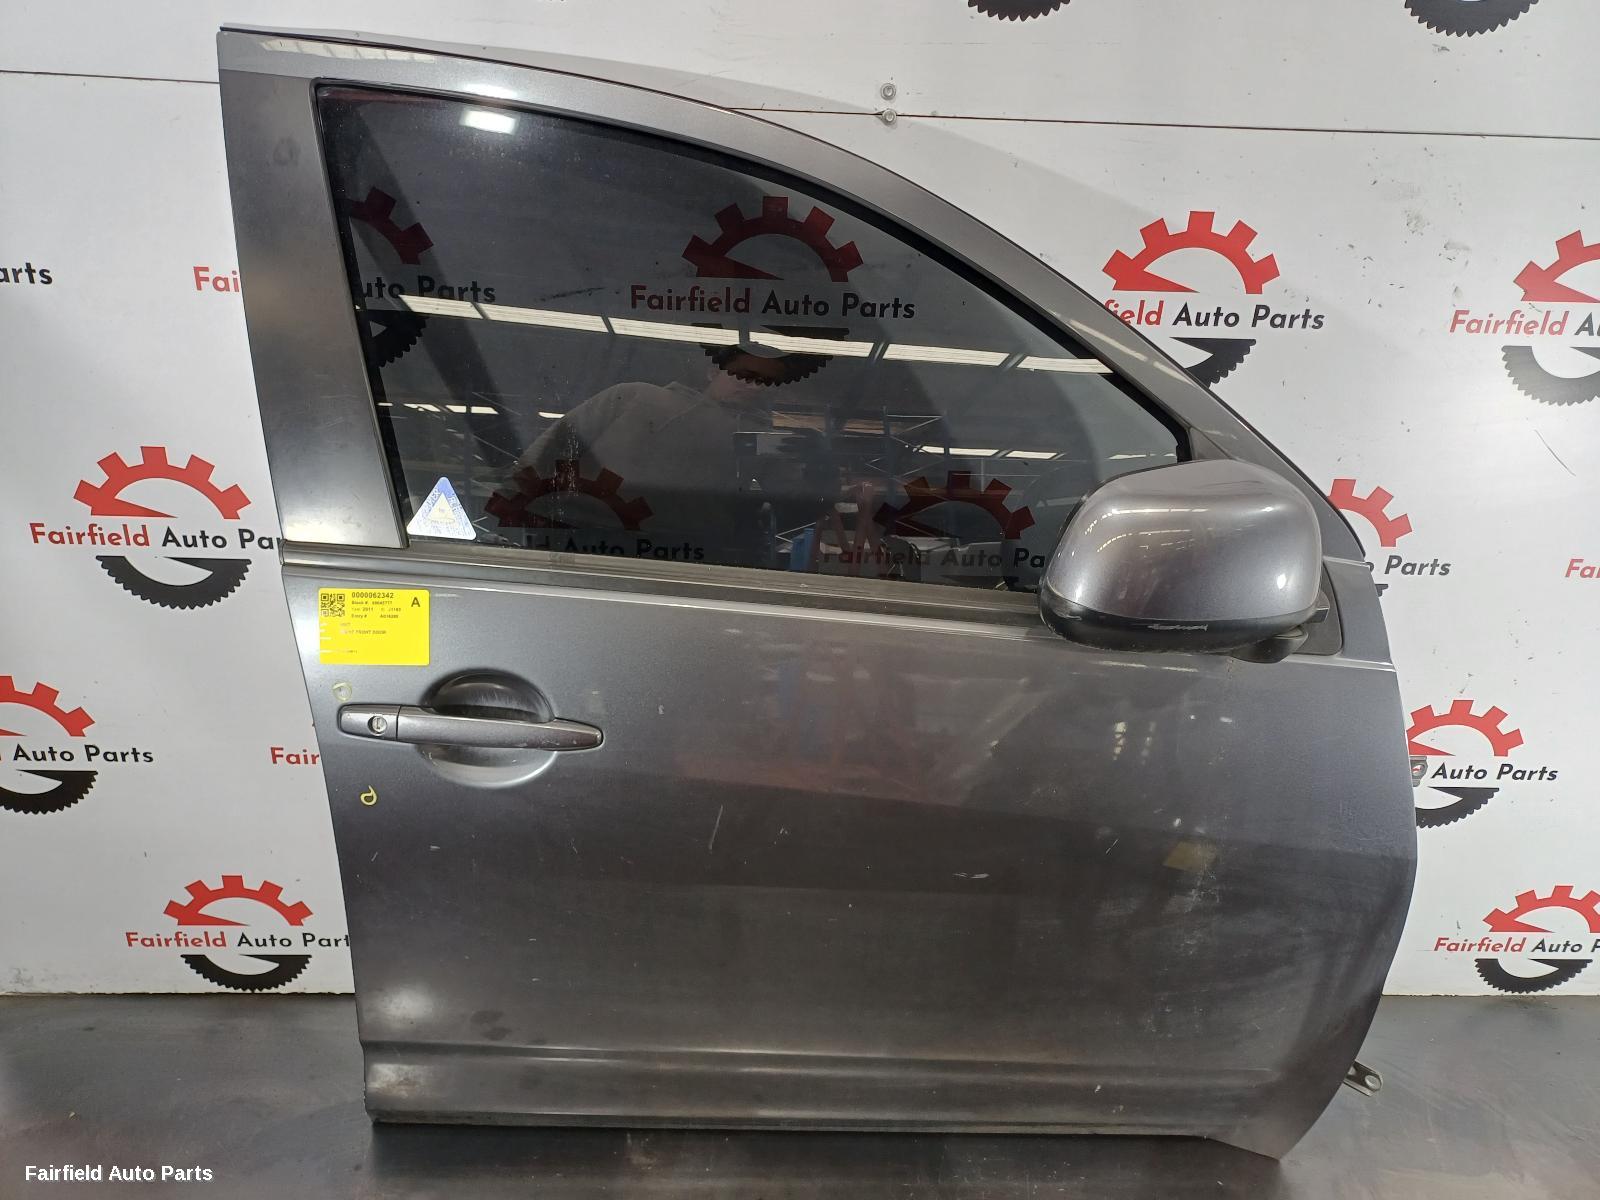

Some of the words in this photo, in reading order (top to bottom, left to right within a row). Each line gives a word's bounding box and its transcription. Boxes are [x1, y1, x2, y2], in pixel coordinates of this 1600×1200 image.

[193, 266, 240, 293] Fai
[417, 275, 497, 303] Parts
[631, 284, 750, 314] Fairfield
[761, 289, 830, 317] Auto
[841, 292, 916, 319] Parts
[1172, 302, 1240, 328] Auto
[1251, 304, 1325, 330] Parts
[1449, 309, 1570, 336] Fairfield
[29, 522, 150, 547] Fairfield
[161, 525, 228, 549] Auto
[636, 538, 705, 561] Parts
[941, 547, 1002, 568] Auto
[1384, 555, 1452, 577] Parts
[351, 591, 394, 599] 0000062342
[410, 596, 421, 608] A
[13, 743, 75, 762] Auto
[84, 744, 154, 763] Parts
[270, 746, 320, 765] Fair
[1431, 762, 1488, 780] Auto
[1496, 763, 1559, 781] Parts
[125, 931, 227, 948] Fairfield
[237, 932, 292, 948] Auto
[1433, 936, 1527, 953] Fairfield
[1531, 938, 1583, 953] Auto
